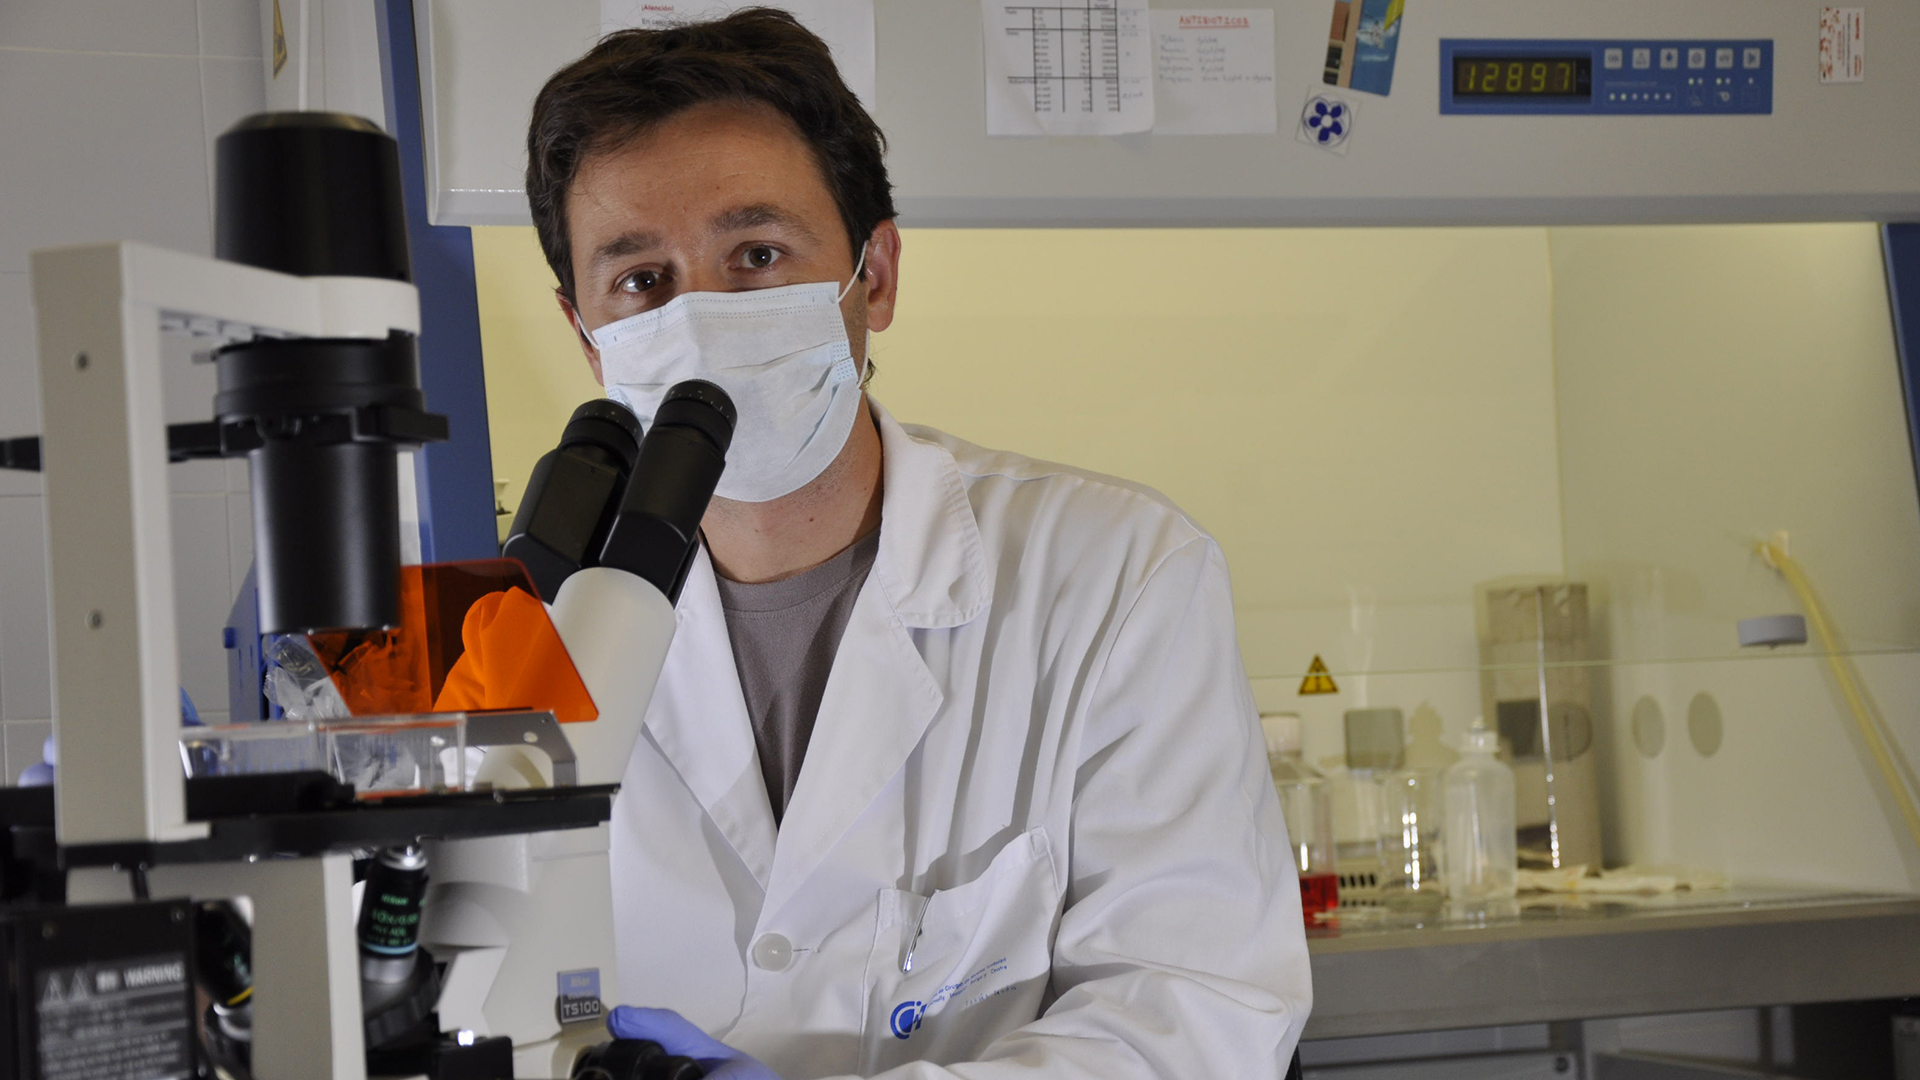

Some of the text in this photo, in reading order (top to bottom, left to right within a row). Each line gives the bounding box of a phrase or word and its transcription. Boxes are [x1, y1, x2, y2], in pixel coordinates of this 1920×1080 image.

[1468, 62, 1571, 93] 12897
[123, 961, 185, 988] WARNING
[563, 1000, 600, 1017] TS100
